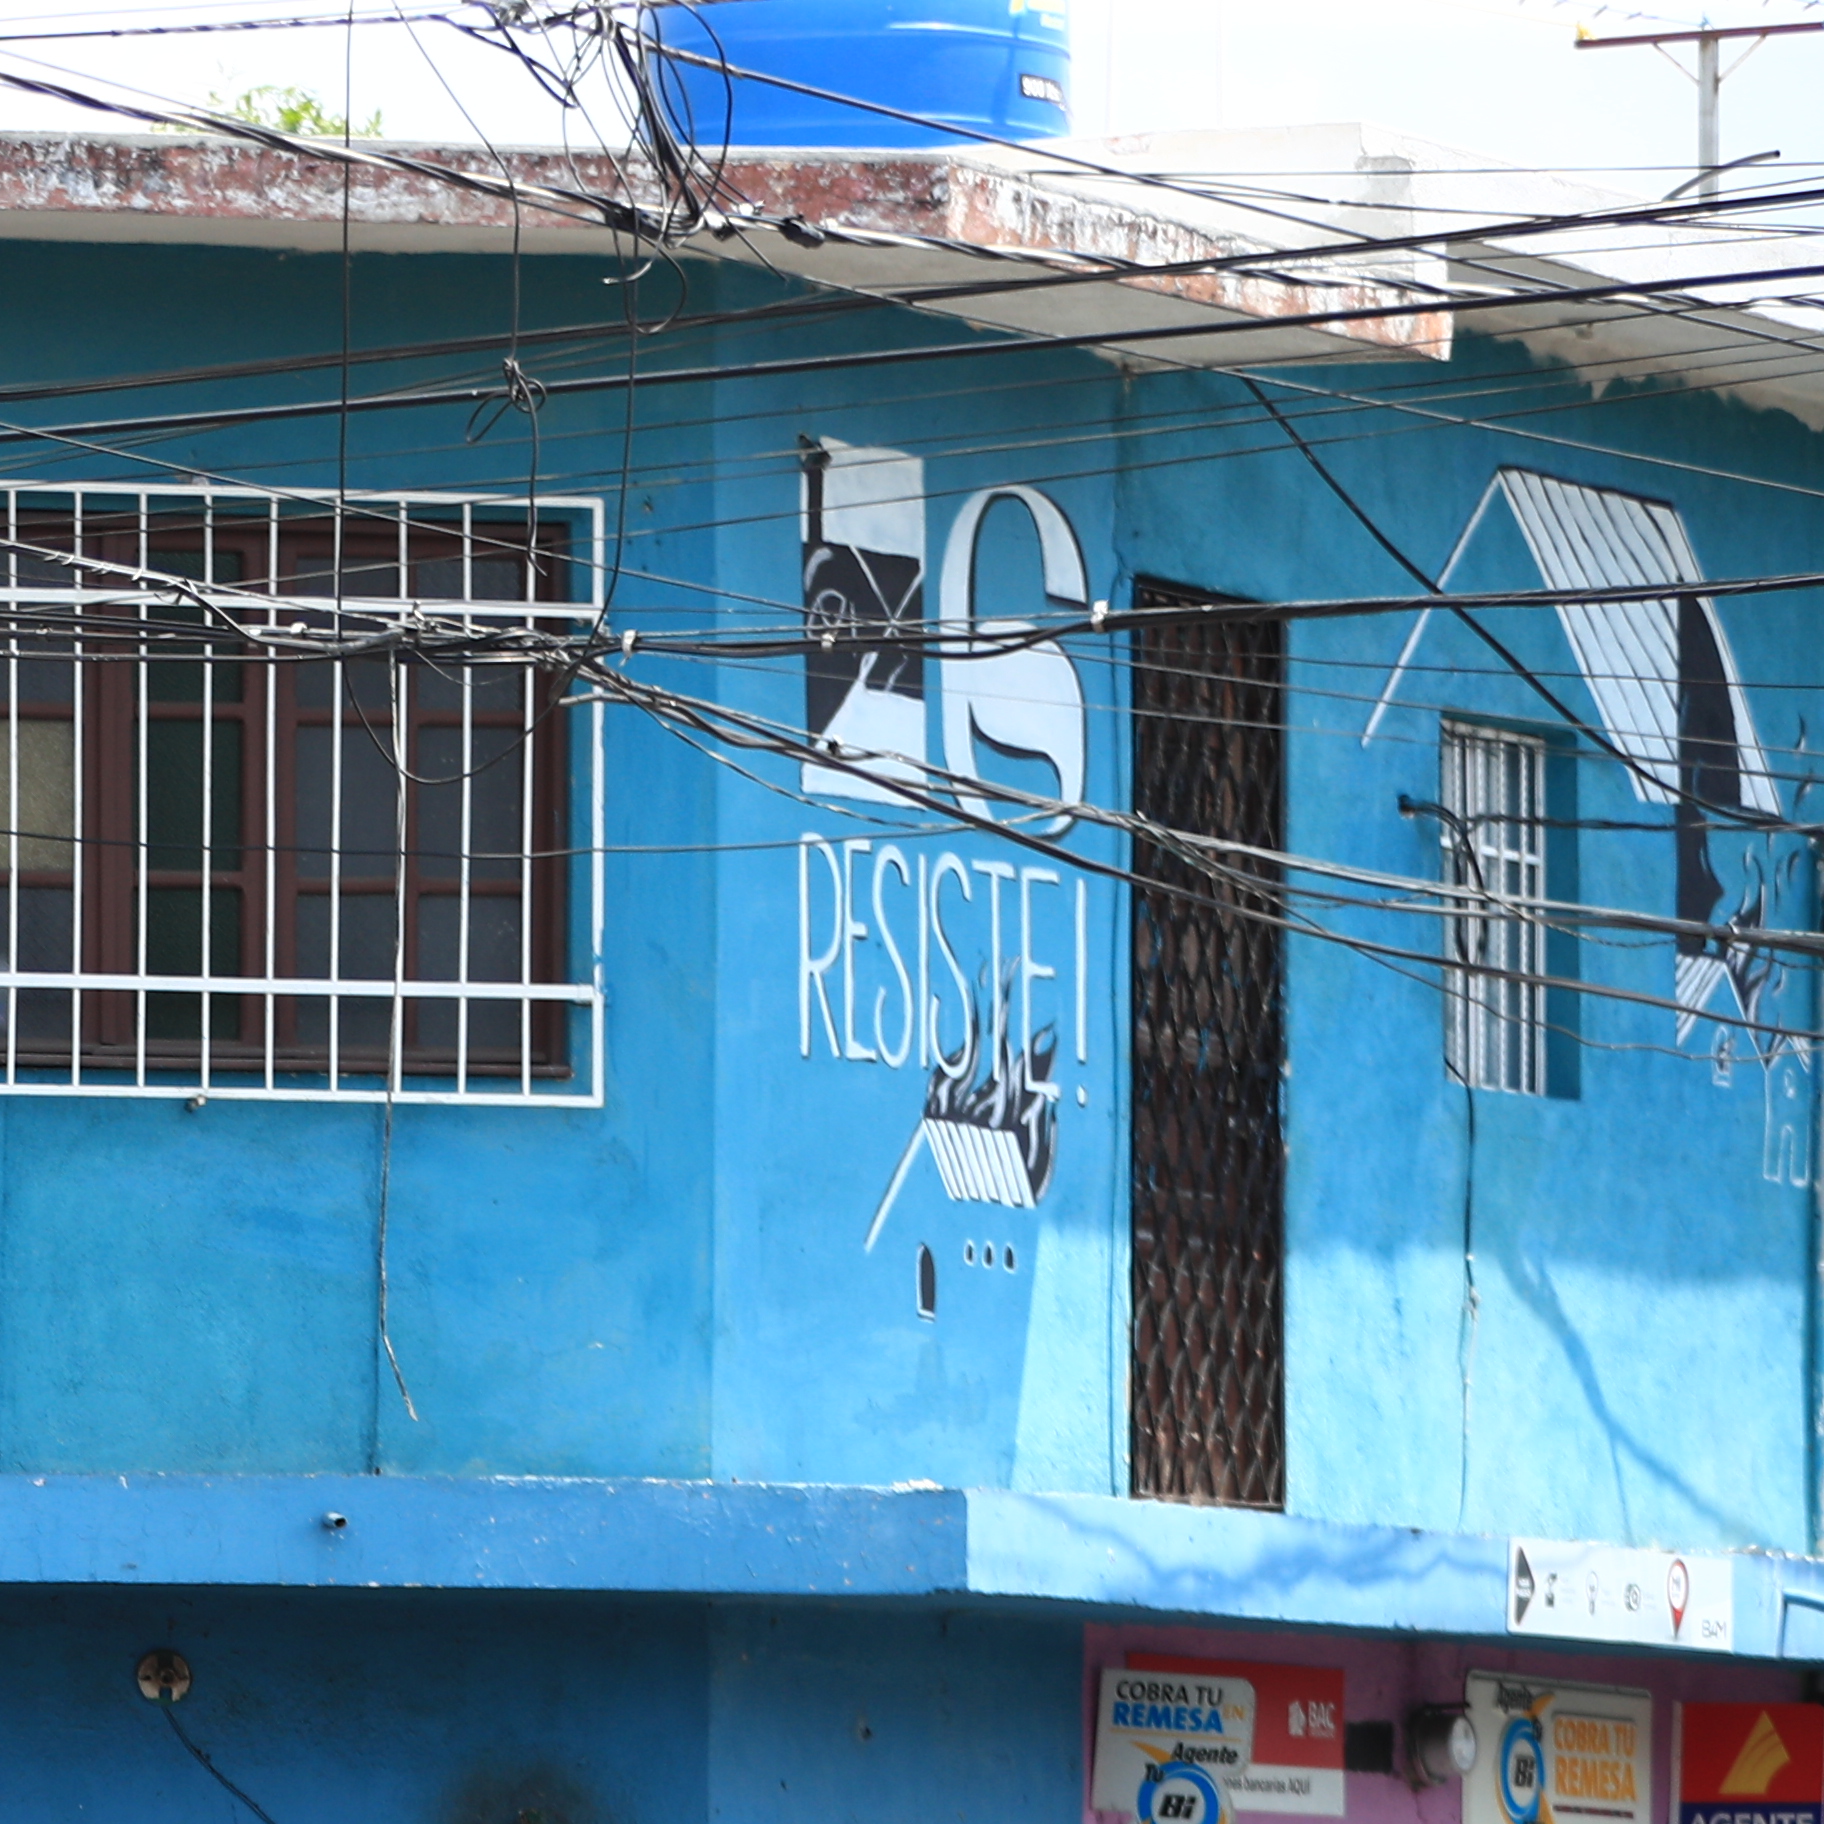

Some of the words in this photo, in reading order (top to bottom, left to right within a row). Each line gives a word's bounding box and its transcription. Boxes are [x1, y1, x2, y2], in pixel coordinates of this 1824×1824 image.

[800, 832, 1088, 1107] RESISTE!
[1115, 1680, 1190, 1704] COBRA
[1195, 1687, 1223, 1706] TU
[1112, 1702, 1224, 1734] REMESA
[1224, 1704, 1245, 1720] EN
[1307, 1700, 1337, 1730] BAC
[1554, 1717, 1610, 1753] COBRA
[1614, 1724, 1635, 1757] TU
[1172, 1742, 1238, 1765] Agente
[1555, 1756, 1637, 1802] REMESA
